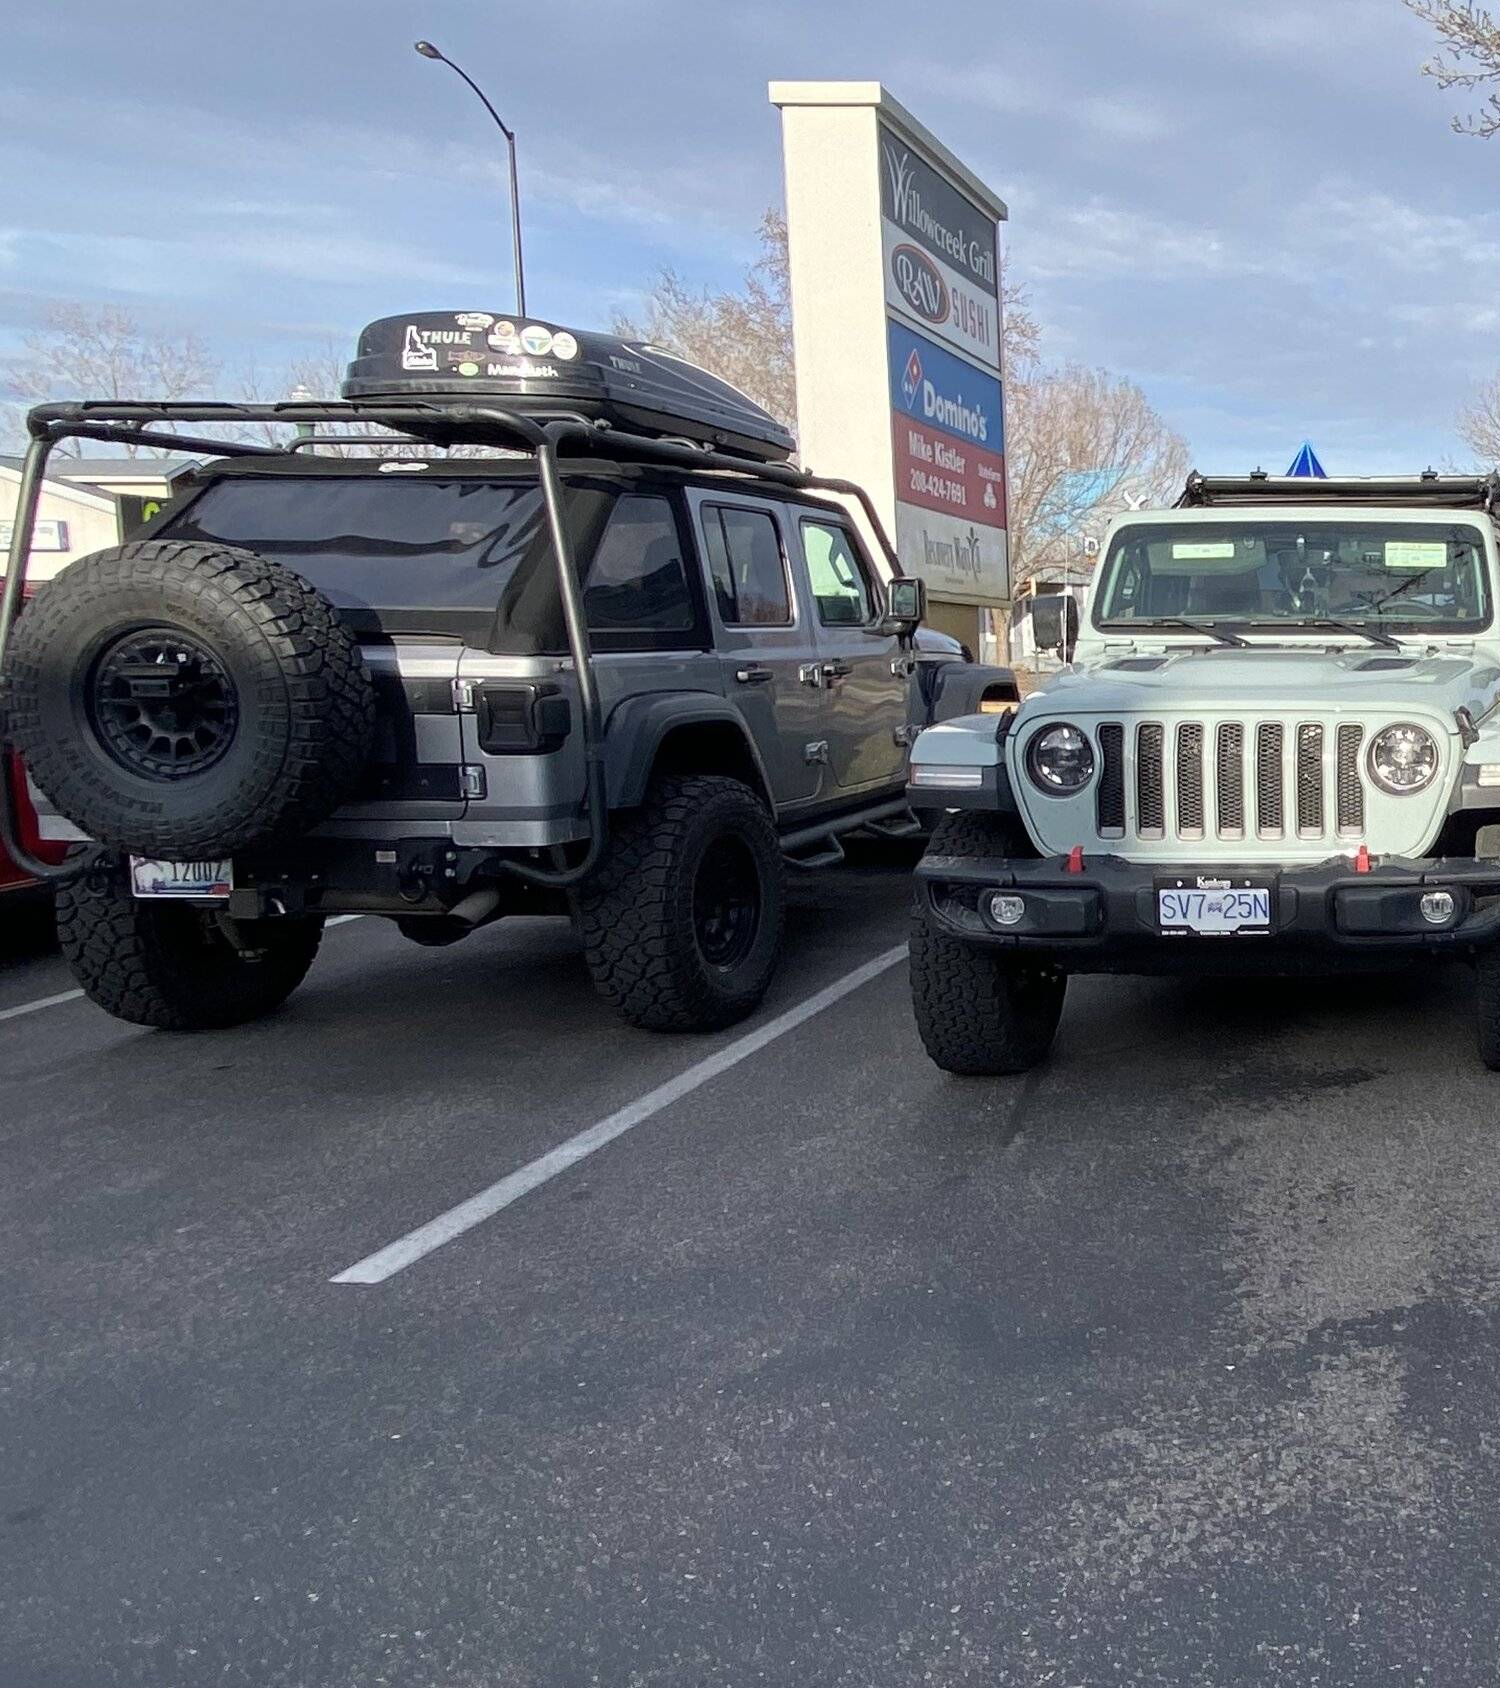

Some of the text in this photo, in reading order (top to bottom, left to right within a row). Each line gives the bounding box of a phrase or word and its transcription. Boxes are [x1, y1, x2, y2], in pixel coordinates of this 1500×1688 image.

[882, 141, 995, 285] Willowcreek Grill
[897, 254, 990, 347] RAW SUSHI
[421, 330, 472, 345] THULE
[923, 379, 988, 441] Domino's
[908, 430, 933, 462] Mike
